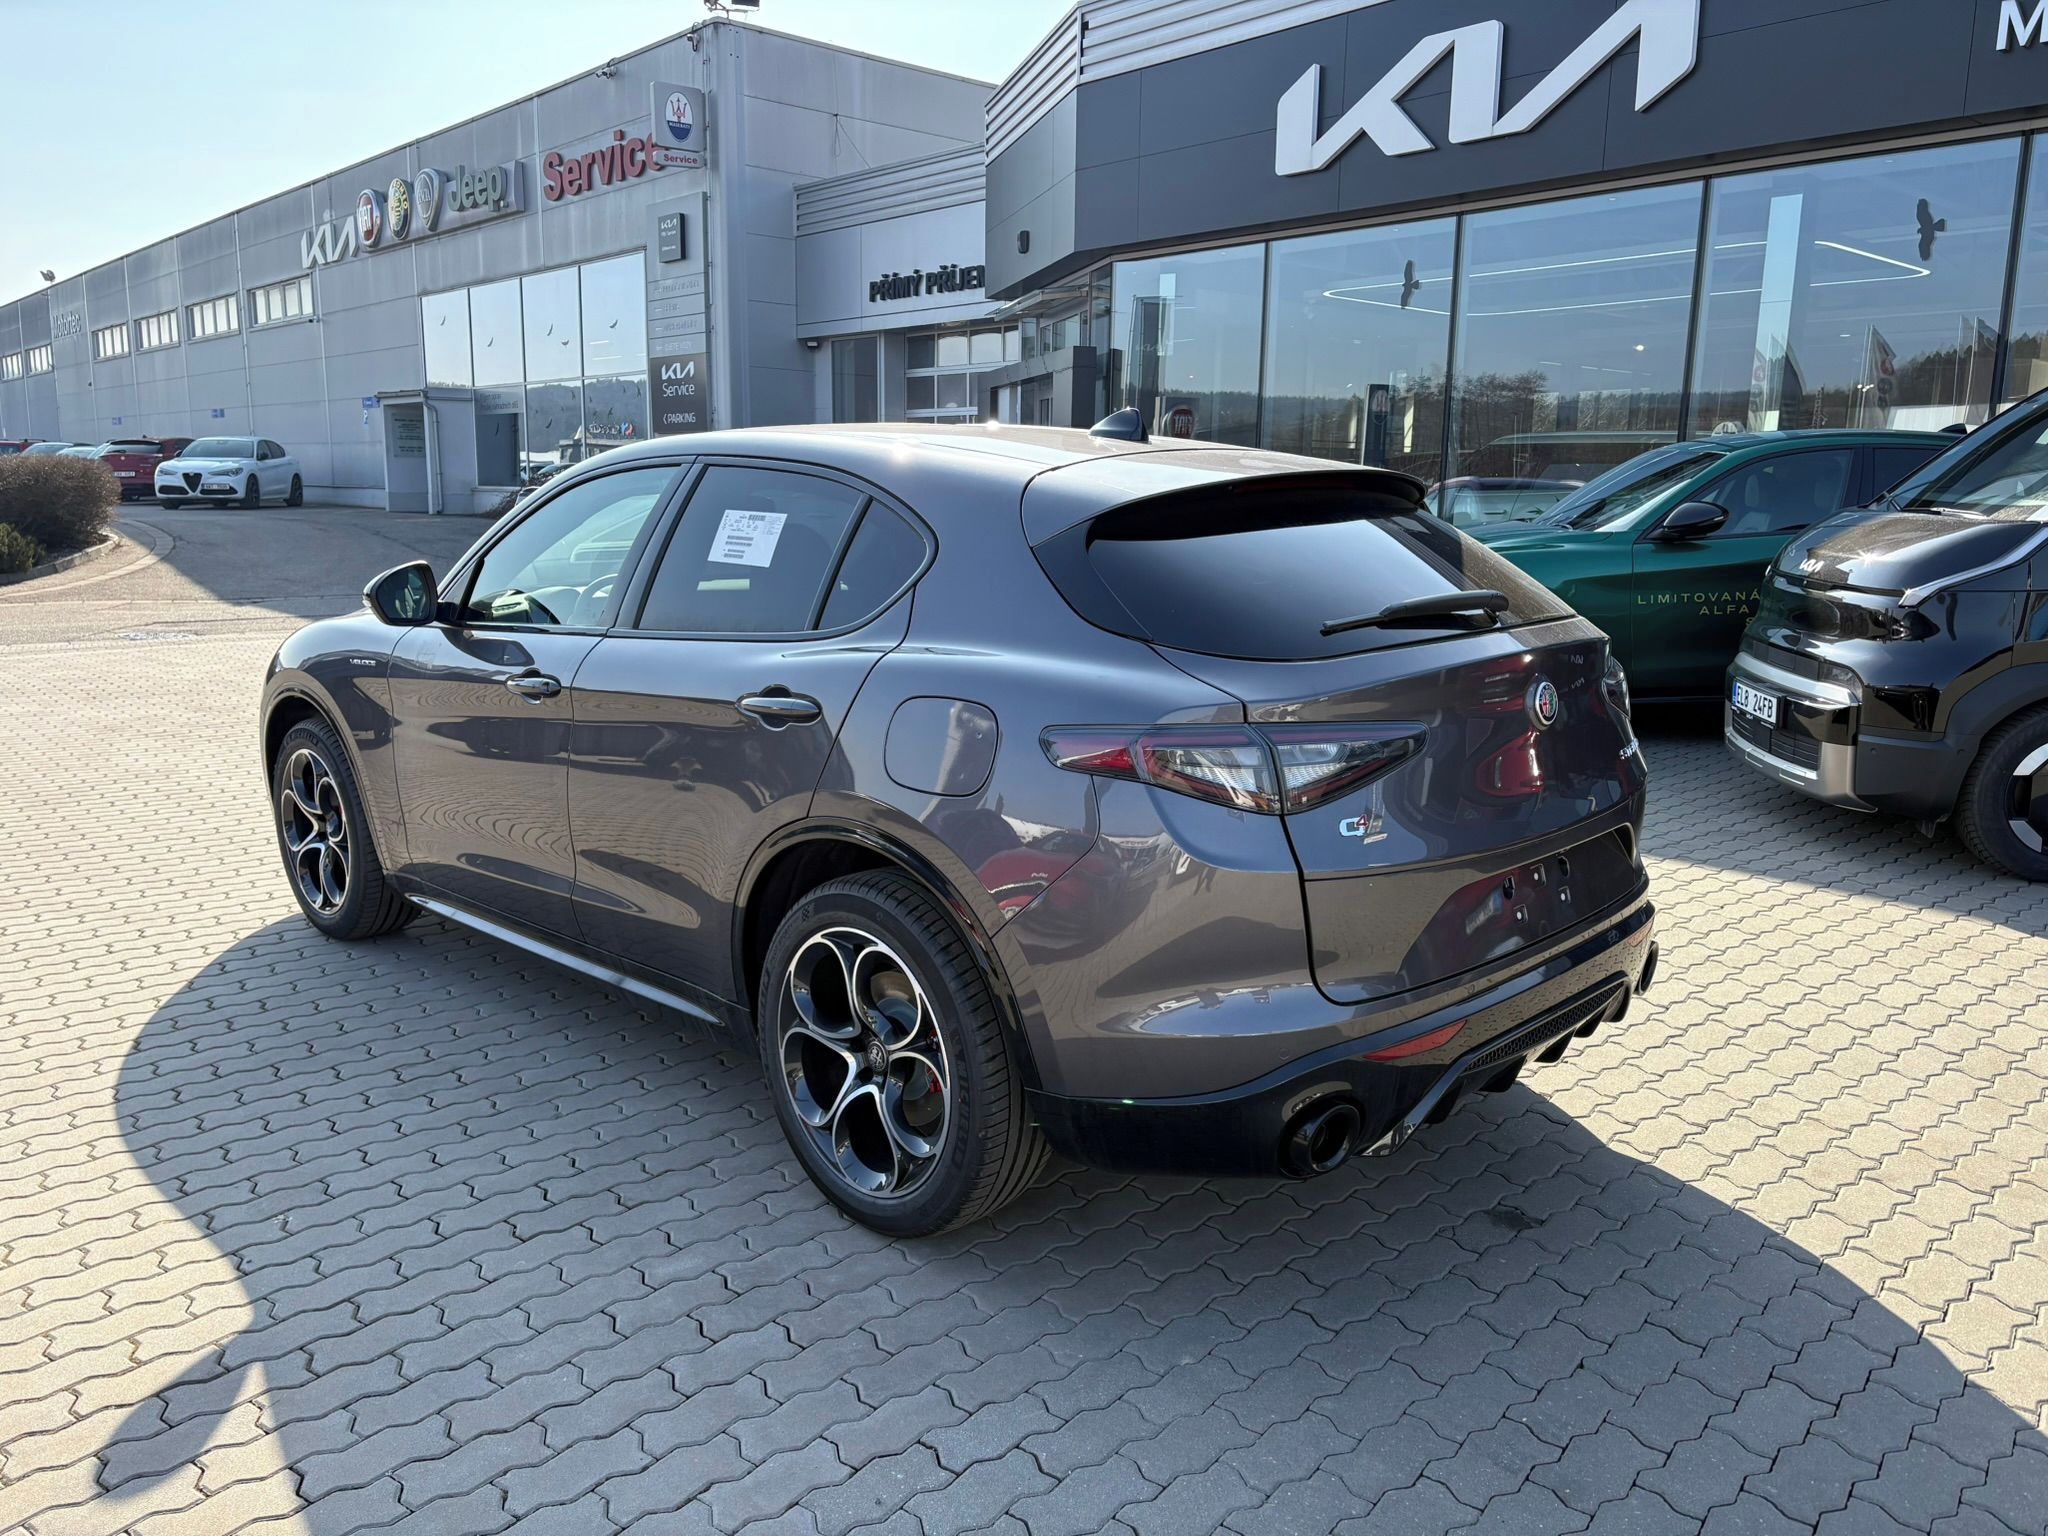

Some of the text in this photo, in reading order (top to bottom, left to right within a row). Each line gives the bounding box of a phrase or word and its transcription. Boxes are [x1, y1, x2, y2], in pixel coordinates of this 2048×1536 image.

[1275, 0, 1700, 176] KIA
[663, 153, 698, 165] Service
[450, 165, 507, 212] Jeep
[661, 217, 677, 229] KIA
[301, 215, 358, 269] KIA
[869, 269, 924, 302] PŘÍMÝ
[661, 360, 695, 380] KIA
[662, 381, 695, 397] Service
[667, 411, 697, 424] PARKING
[1637, 588, 1760, 605] LIMITOVANÁ
[1699, 604, 1749, 616] ALFA
[349, 658, 377, 667] VELOCE
[1752, 693, 1773, 719] 24FB
